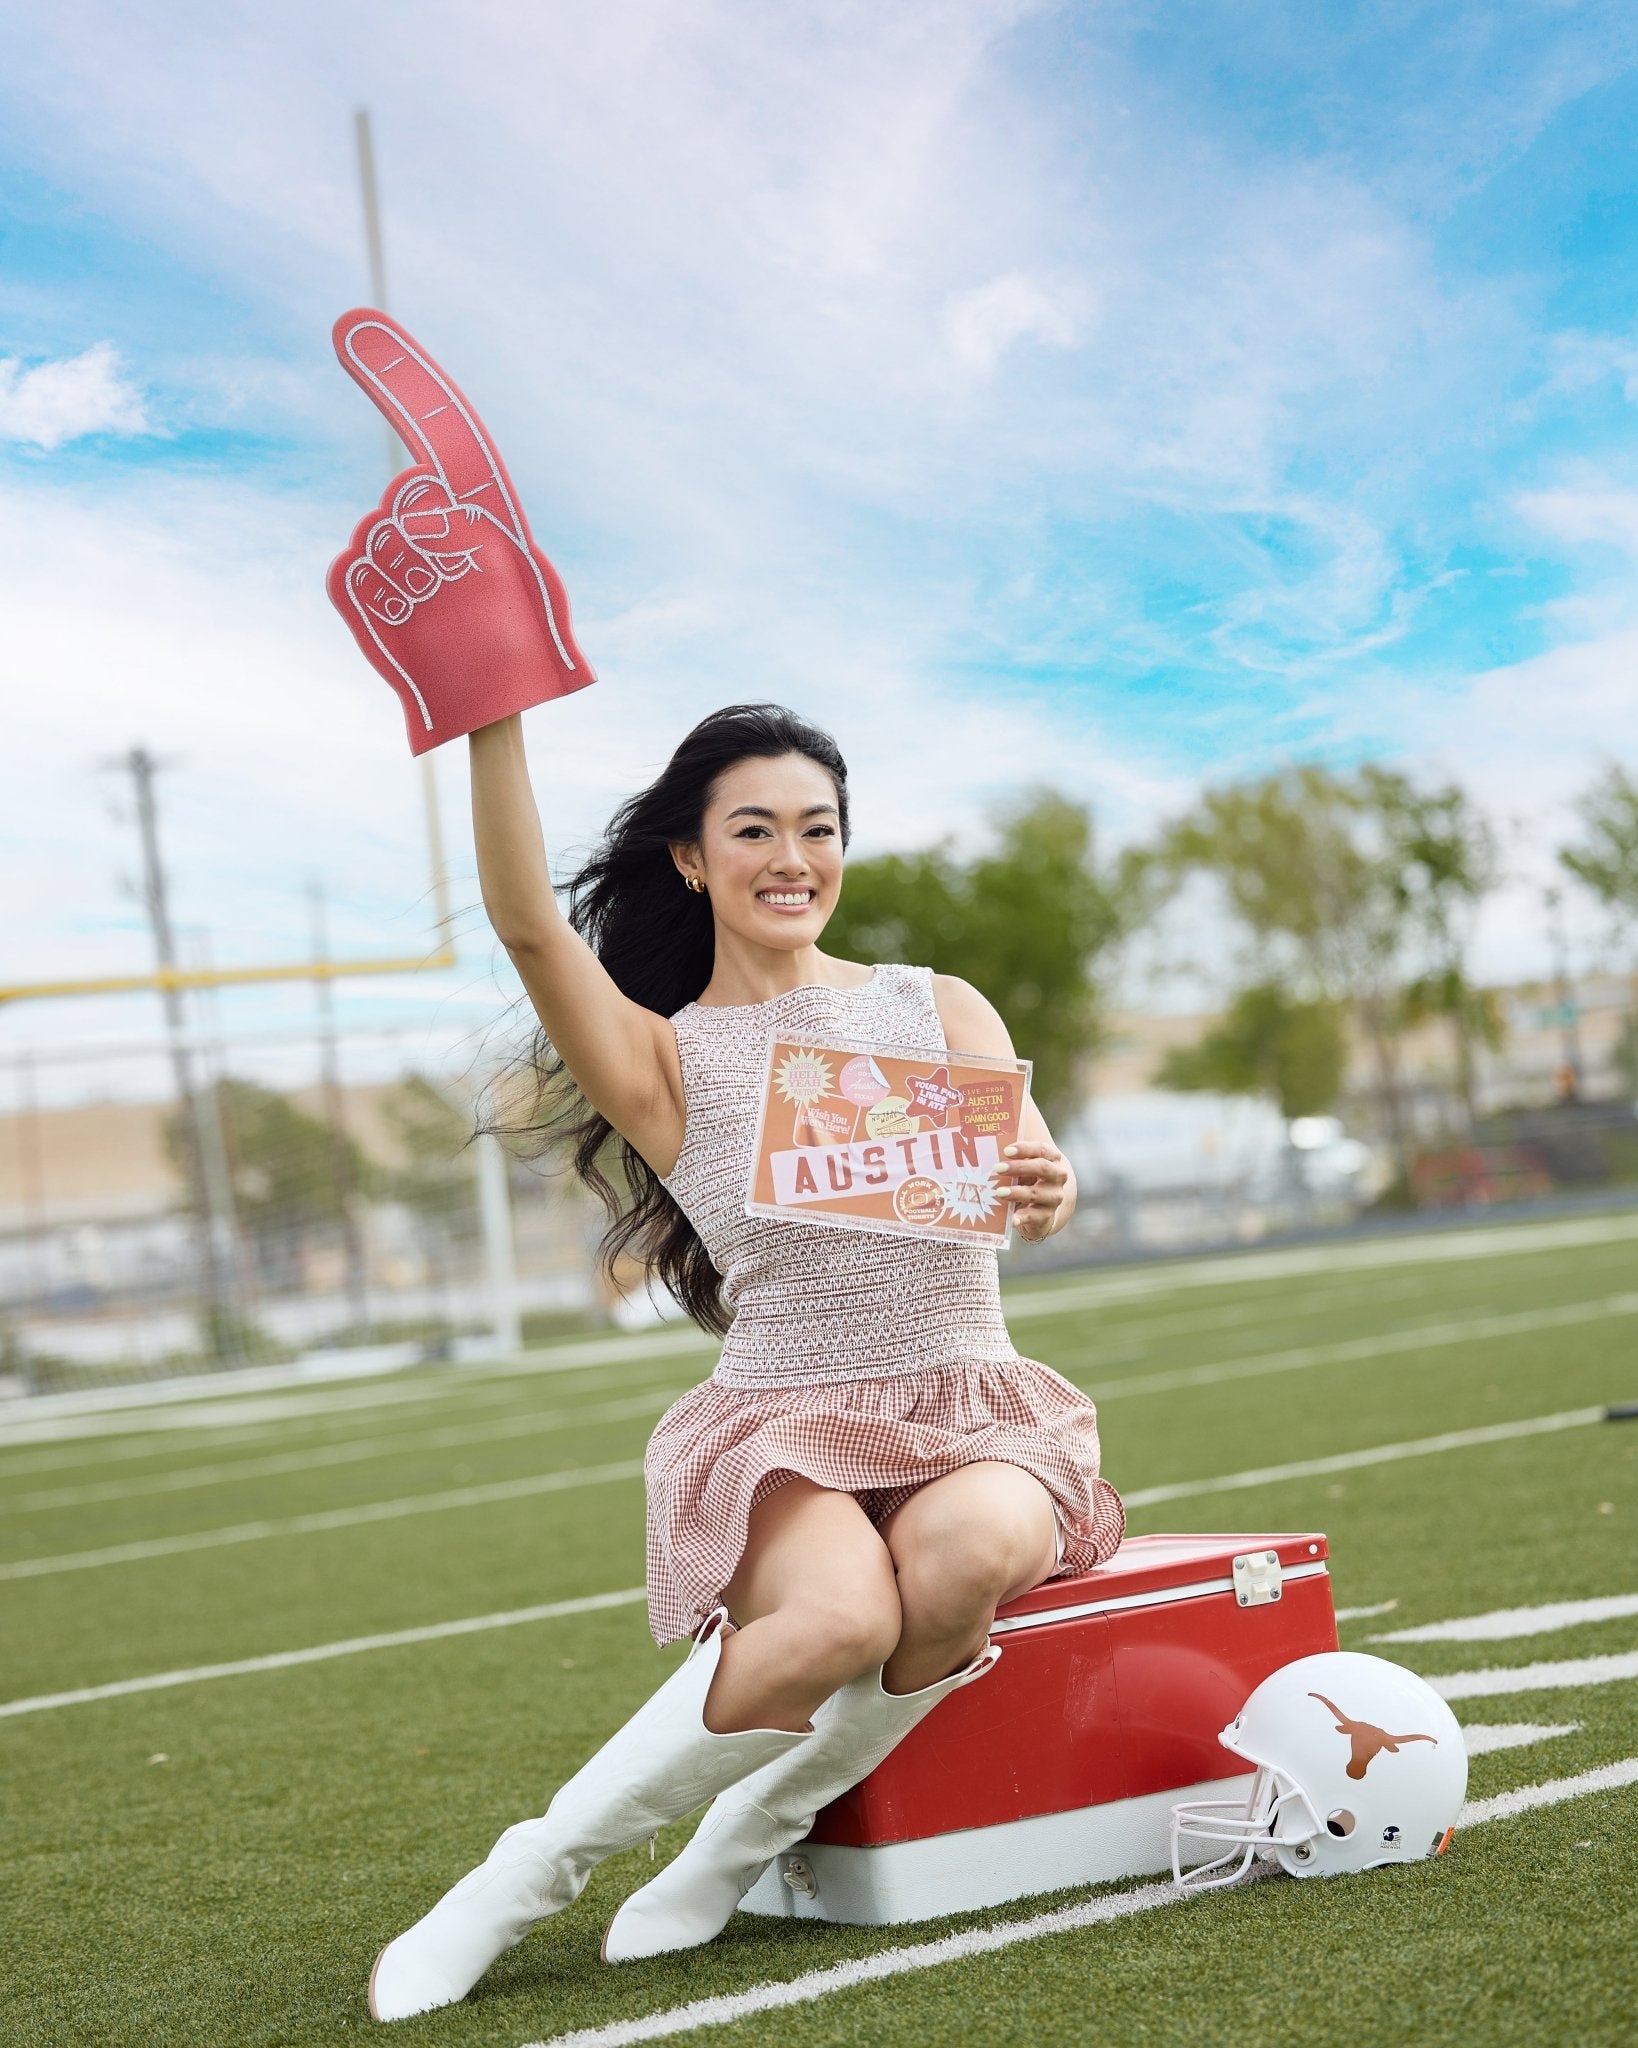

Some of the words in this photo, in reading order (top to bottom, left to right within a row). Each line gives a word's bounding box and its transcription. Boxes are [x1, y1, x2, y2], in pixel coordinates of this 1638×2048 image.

[789, 1071, 822, 1079] HELL
[788, 1079, 821, 1087] YEAH
[915, 1080, 939, 1093] YOUR
[919, 1089, 948, 1105] LIVES
[962, 1088, 981, 1096] LIVE
[916, 1096, 928, 1106] IN
[927, 1101, 947, 1111] ATX
[967, 1095, 1003, 1107] AUSTIN
[807, 1107, 830, 1121] Wish
[831, 1112, 848, 1125] You
[880, 1112, 898, 1123] MORE
[964, 1113, 987, 1124] DAMN
[986, 1111, 1010, 1122] GOOD
[801, 1115, 825, 1129] Were
[825, 1120, 851, 1135] Here!
[795, 1131, 980, 1193] AUSTIN
[907, 1180, 933, 1189] WORK
[956, 1182, 988, 1204] TX
[903, 1207, 938, 1215] FOOTBALL
